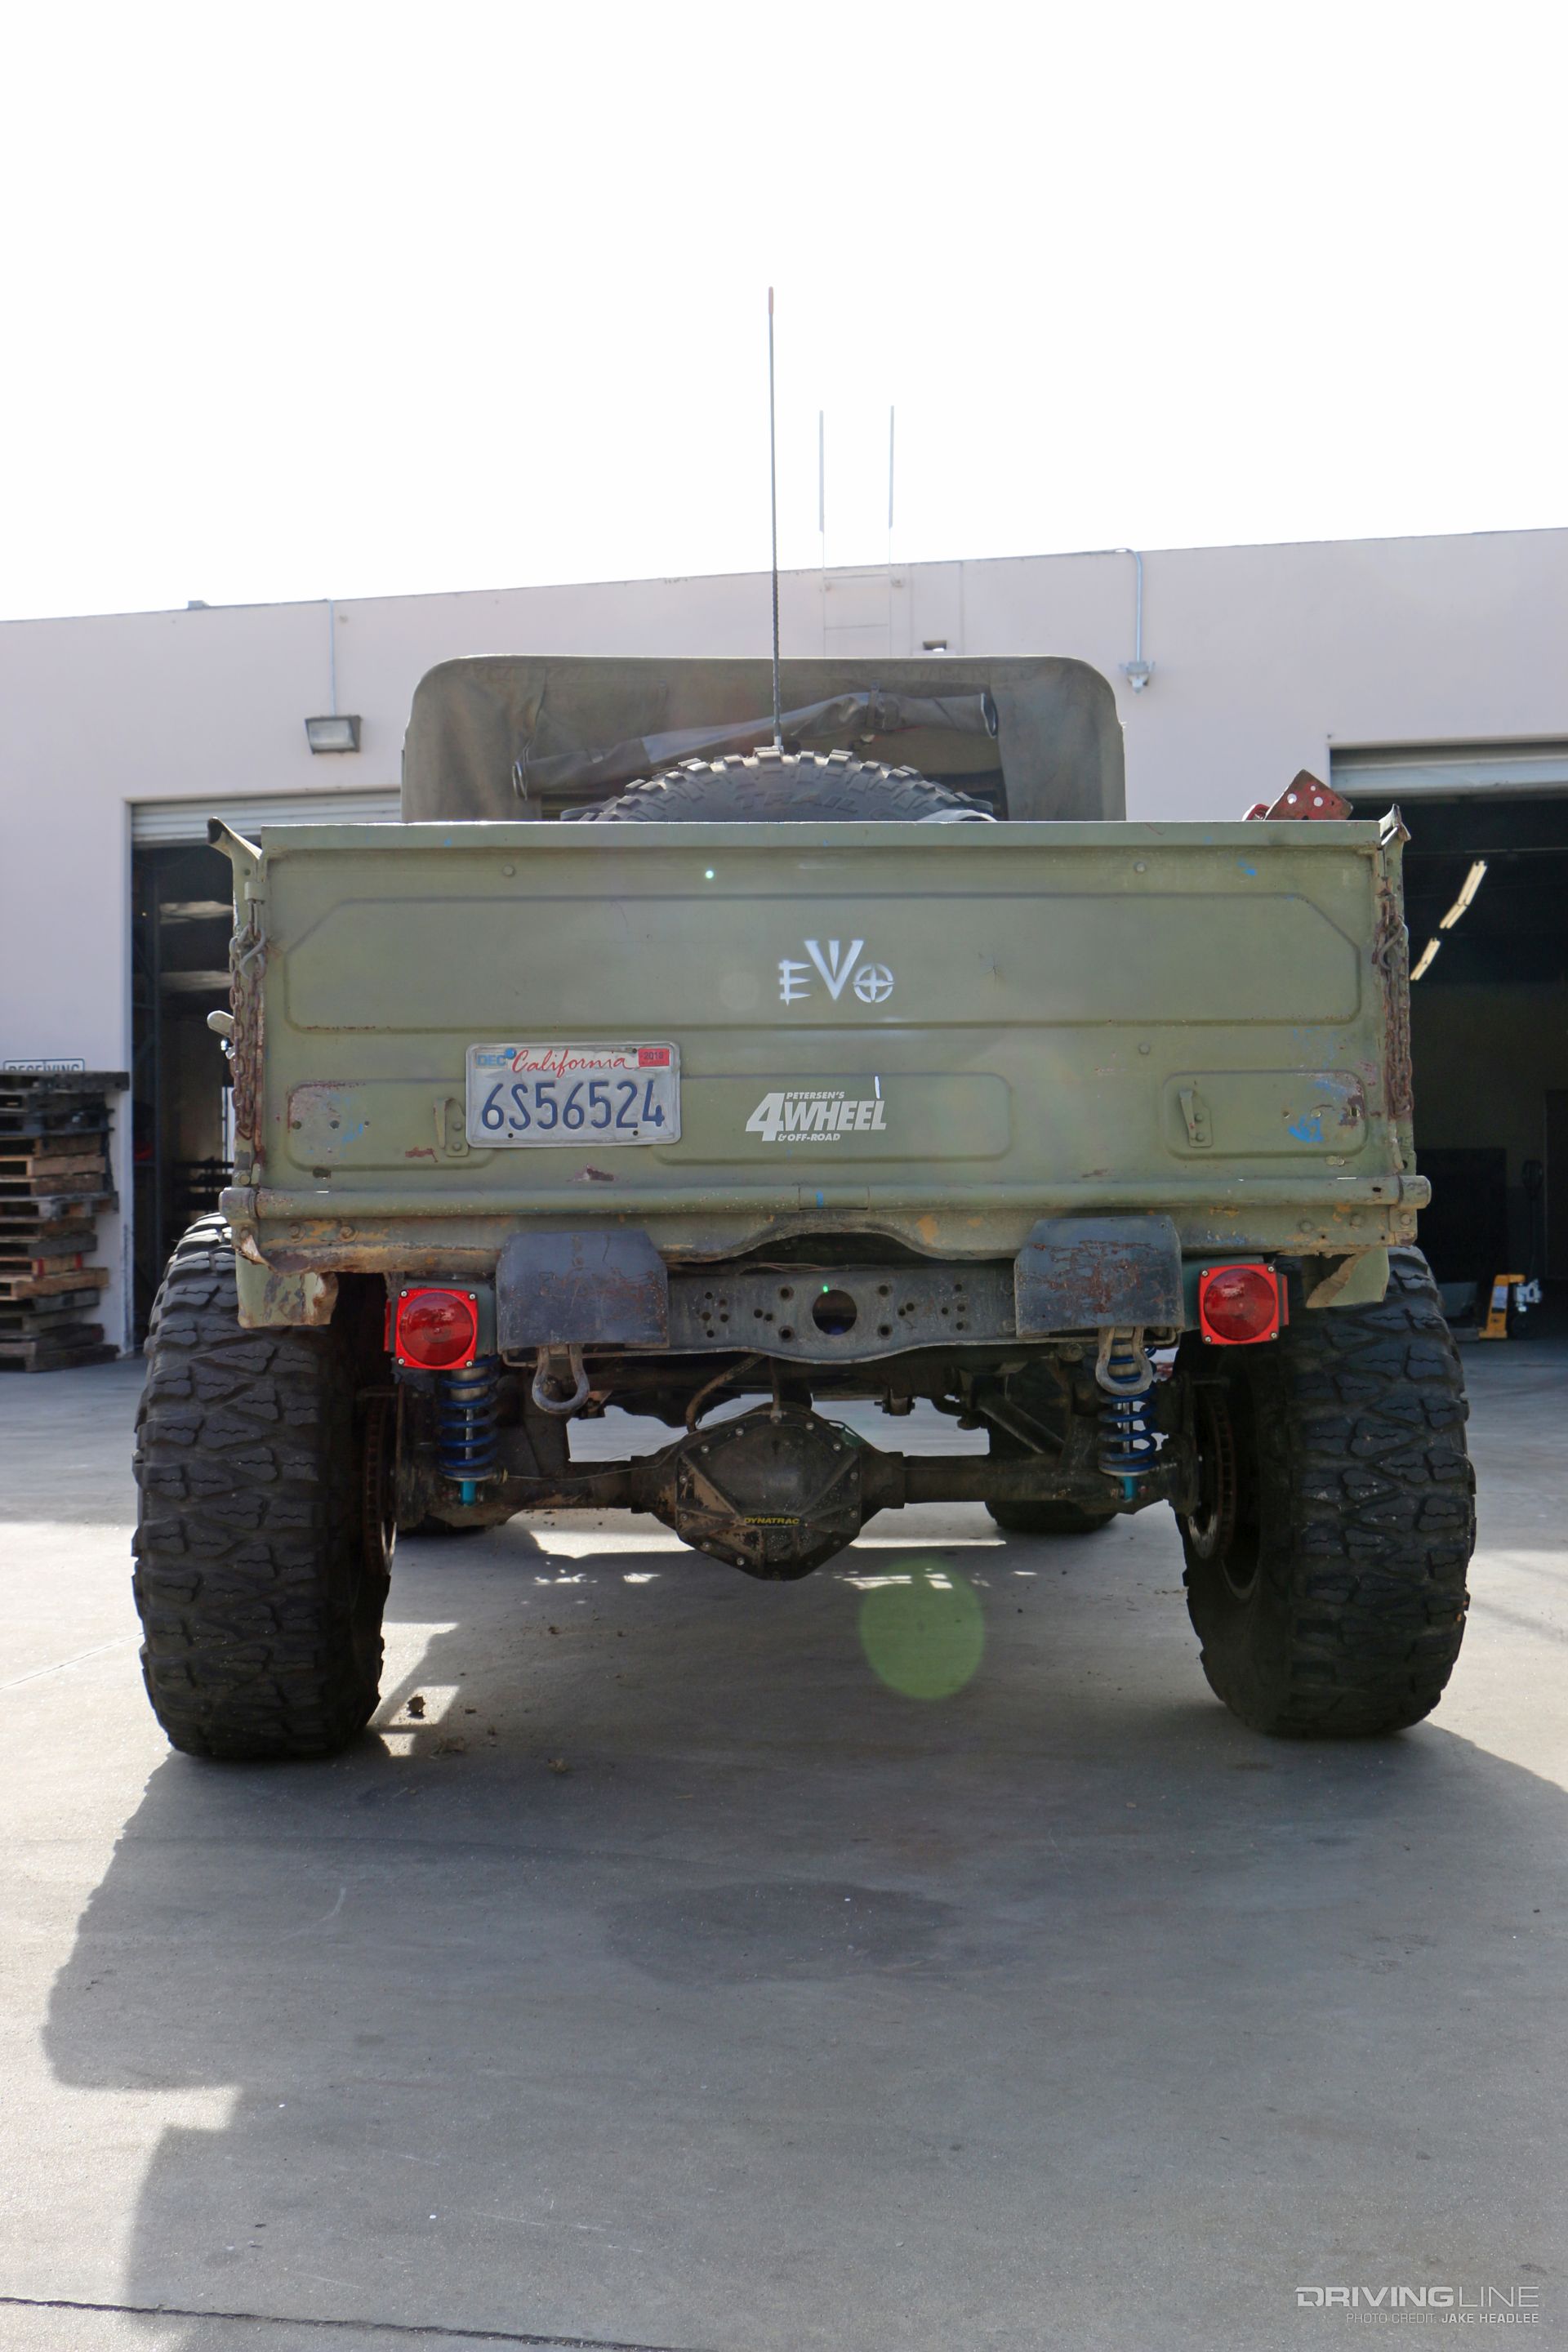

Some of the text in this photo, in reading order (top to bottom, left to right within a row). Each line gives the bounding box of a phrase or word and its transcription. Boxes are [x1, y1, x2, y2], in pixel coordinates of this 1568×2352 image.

[477, 1054, 506, 1066] DEC
[512, 1049, 639, 1078] California
[786, 1091, 845, 1099] PETERSEN'S
[482, 1080, 666, 1130] 6S56524
[787, 1133, 841, 1142] OFF-ROAD
